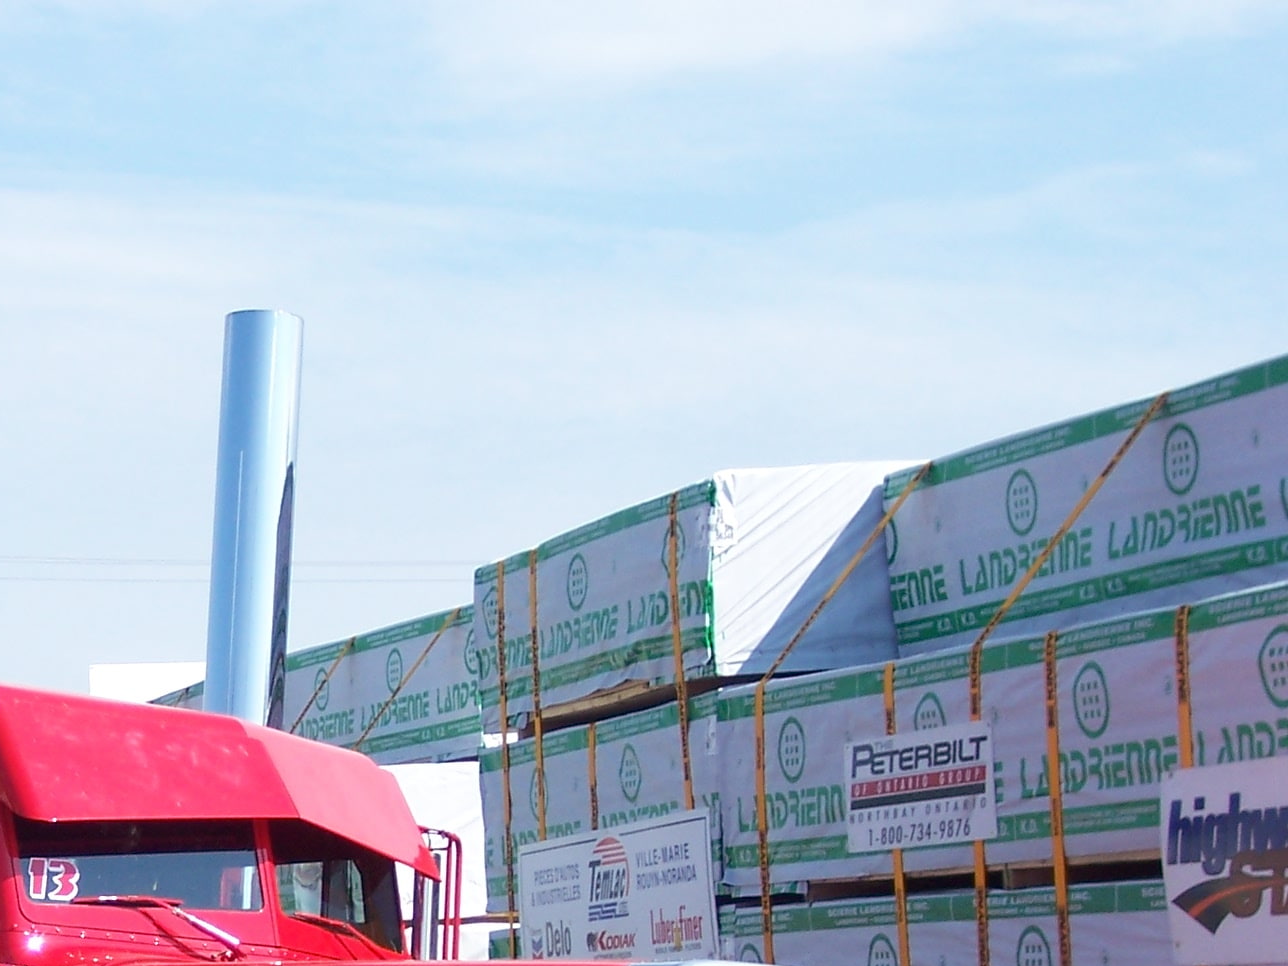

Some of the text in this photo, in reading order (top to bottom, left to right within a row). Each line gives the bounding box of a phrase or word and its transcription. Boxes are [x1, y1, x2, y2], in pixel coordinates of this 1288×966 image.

[1108, 484, 1267, 560] LANDRIENNE
[852, 736, 987, 778] PETERBILT
[876, 774, 929, 795] ONTARIO
[938, 767, 981, 785] GROUP
[925, 797, 987, 815] ONTARIO
[868, 818, 971, 847] 1-800-734-9876
[635, 843, 690, 868] VILLE-MARIE
[28, 857, 80, 901] 13
[636, 865, 697, 891] ROUYN-NORANDA
[545, 920, 572, 957] Delo
